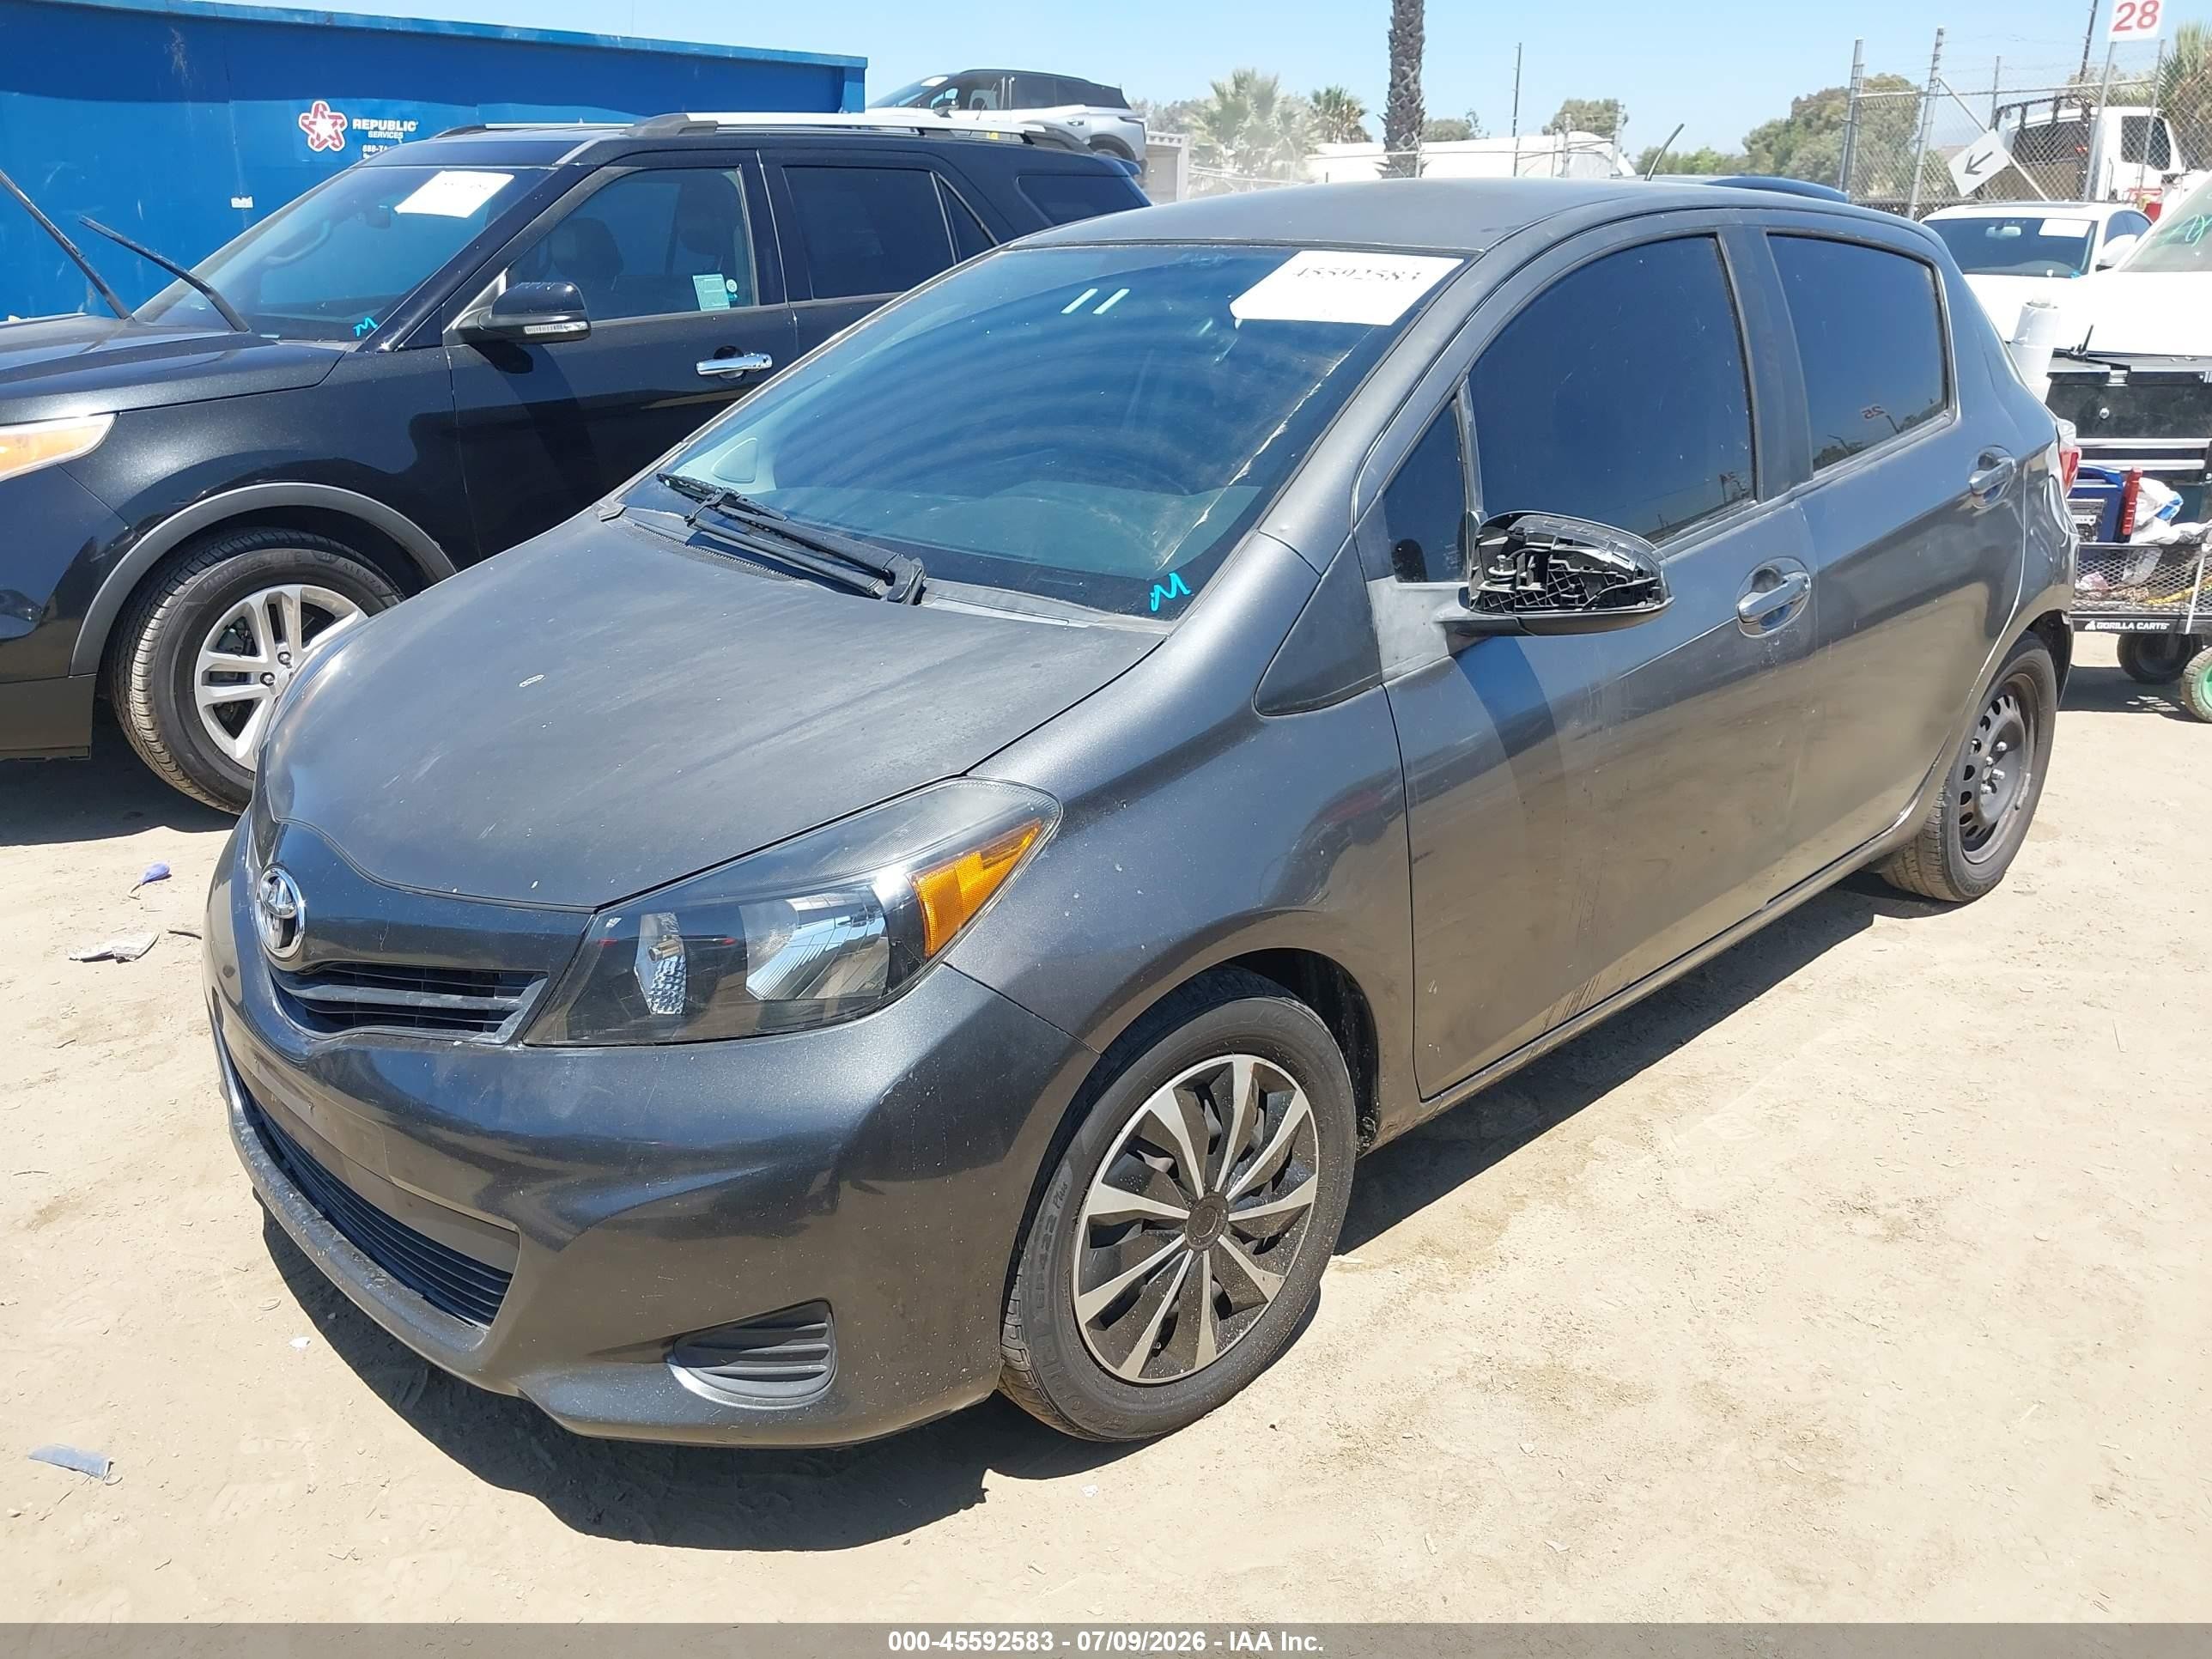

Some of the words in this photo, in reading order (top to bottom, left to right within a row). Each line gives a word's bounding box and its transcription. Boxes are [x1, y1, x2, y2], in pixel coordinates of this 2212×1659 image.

[2112, 0, 2160, 32] 28
[352, 118, 417, 132] REPUBLIC
[368, 131, 404, 139] SERVICES
[2096, 622, 2135, 630] GORILLA
